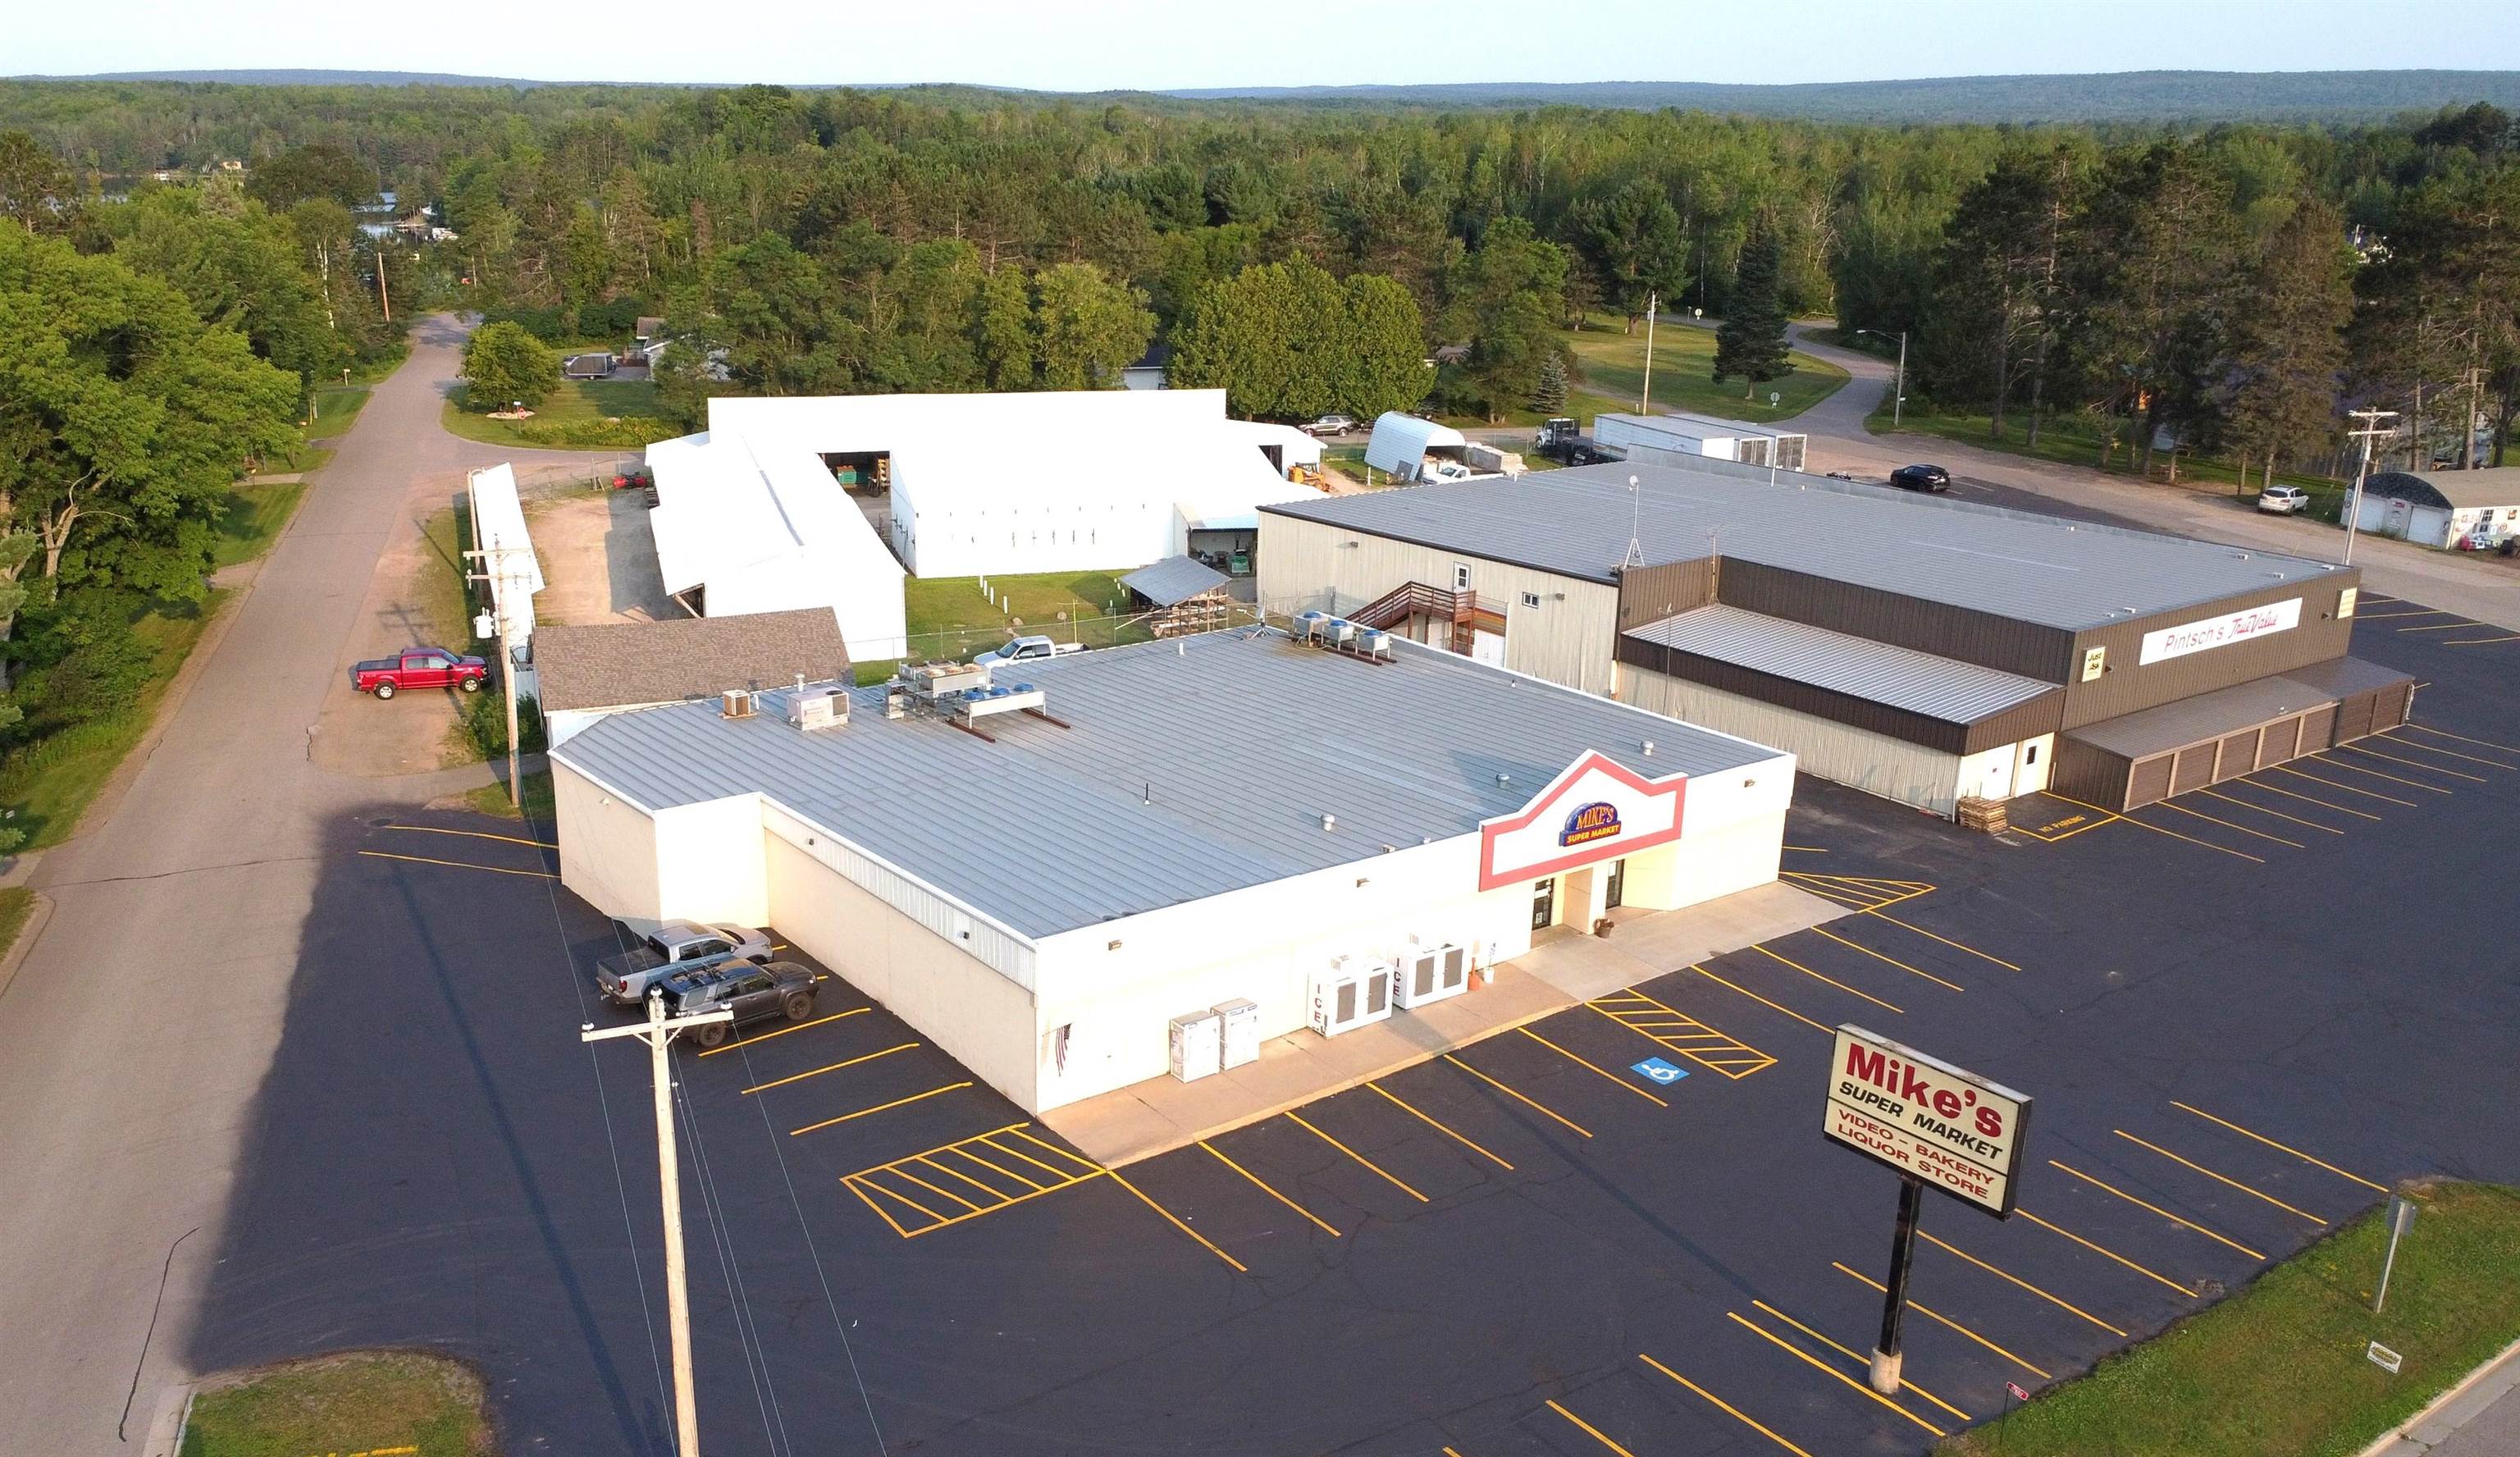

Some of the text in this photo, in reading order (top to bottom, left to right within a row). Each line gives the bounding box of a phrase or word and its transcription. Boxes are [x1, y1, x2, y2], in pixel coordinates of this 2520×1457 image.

[2164, 626, 2224, 652] Pintschs
[1567, 824, 1620, 843] SUPER MARKET
[1575, 806, 1614, 830] MIKE'S
[1393, 957, 1402, 998] ICE
[1313, 984, 1322, 1024] ICE
[1846, 1042, 2002, 1138] Mike's
[1839, 1080, 2002, 1159] SUPER MARKET
[1838, 1108, 1893, 1140] VIDEO
[1915, 1143, 1995, 1185] BAKERY
[1838, 1123, 1988, 1199] LIQUOR STORE
